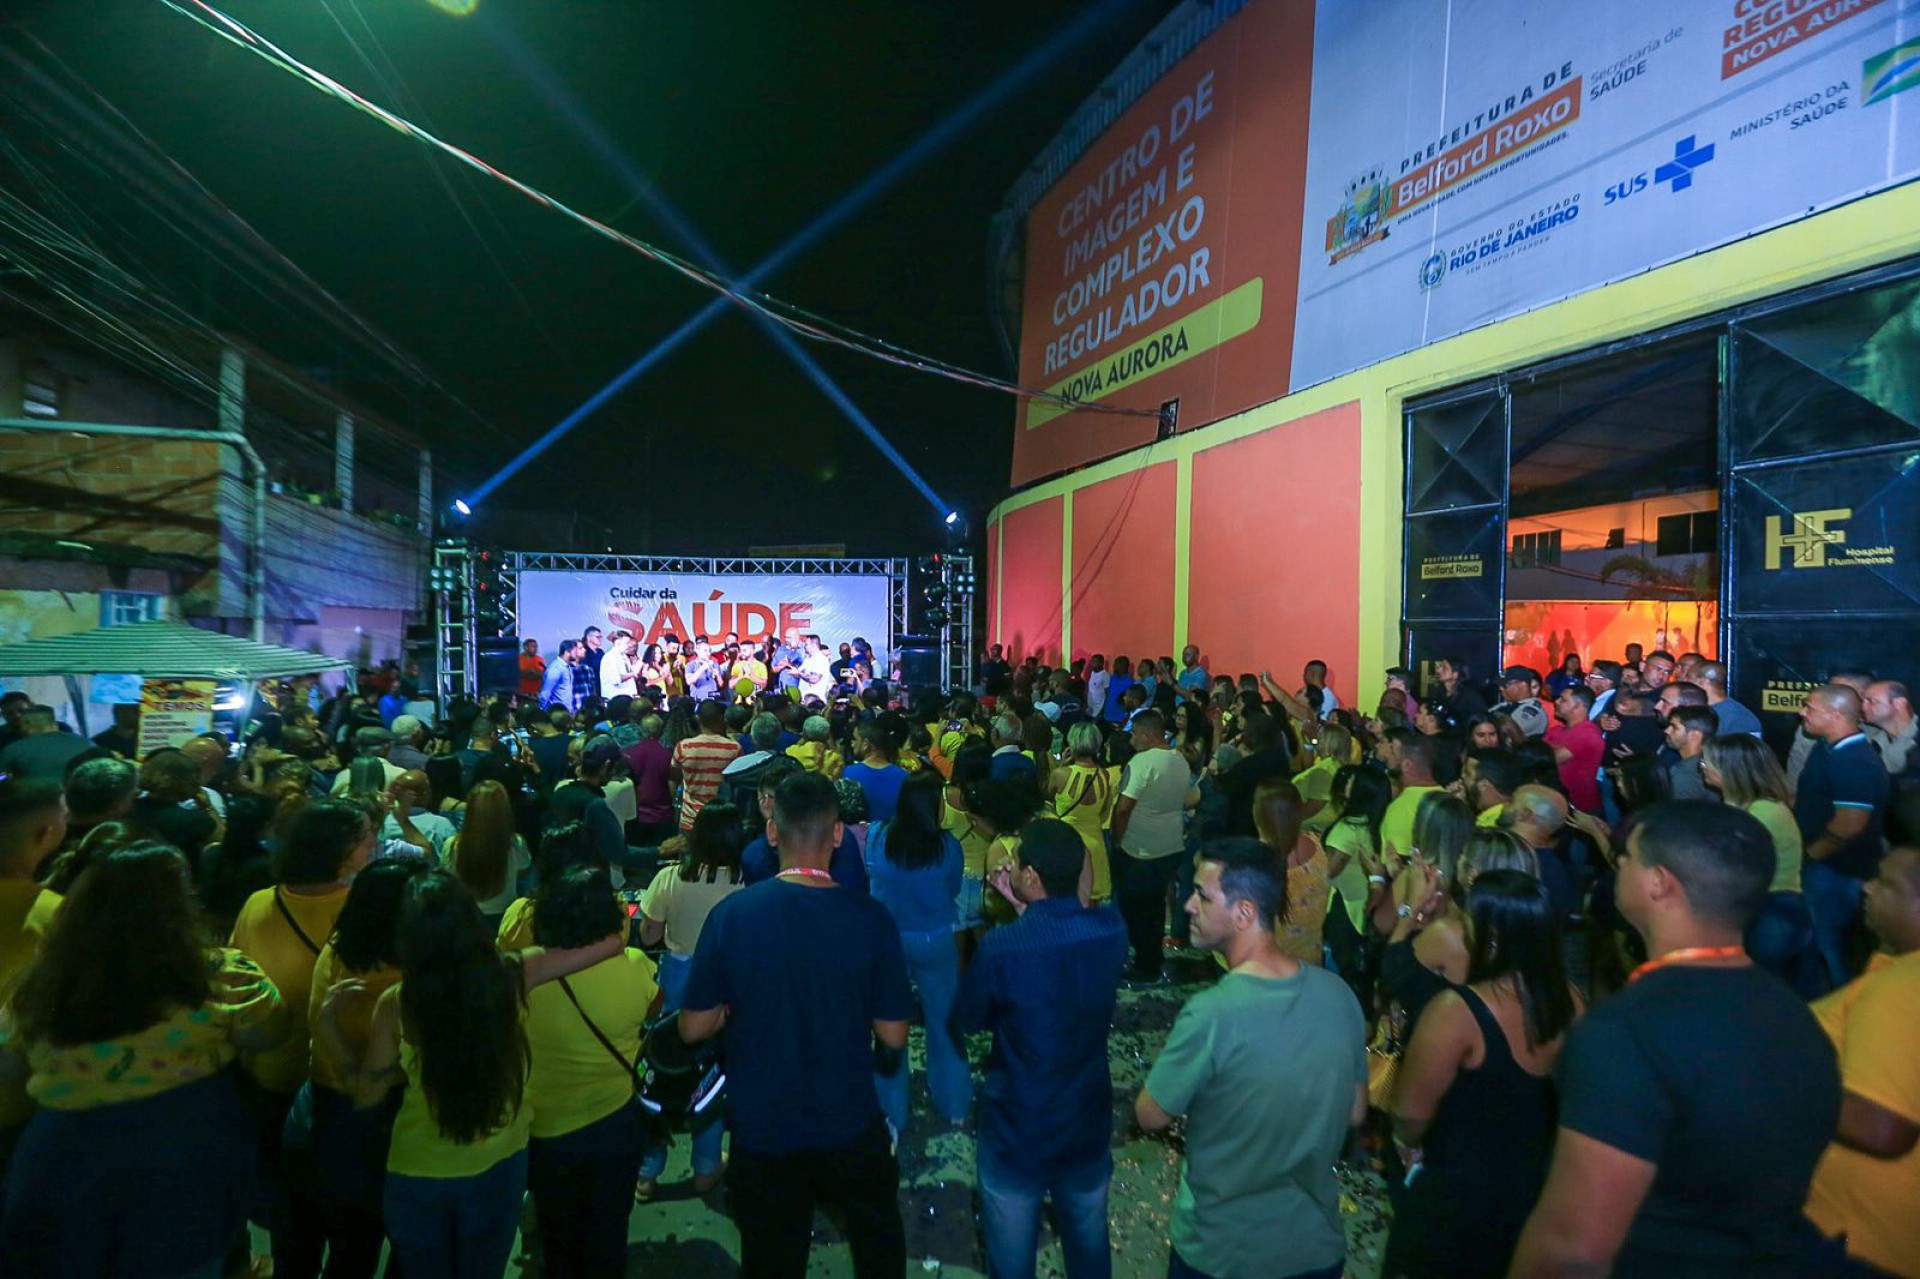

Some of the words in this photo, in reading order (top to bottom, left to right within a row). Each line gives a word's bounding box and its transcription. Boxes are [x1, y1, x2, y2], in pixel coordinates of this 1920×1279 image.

[1723, 0, 1820, 49] REGU
[1733, 24, 1799, 68] NOVA
[1590, 58, 1648, 102] SAÚDE
[1591, 39, 1661, 86] Secretaria
[1664, 26, 1684, 44] de
[1401, 85, 1533, 174] PREFEITURA
[1543, 60, 1573, 91] DE
[1730, 92, 1822, 140] MINISTÉRIO
[1825, 80, 1850, 98] DA
[1790, 96, 1849, 130] SAÚDE
[1057, 126, 1161, 238] CENTRO
[1169, 69, 1215, 147] DE
[1398, 132, 1489, 208] Belford
[1063, 172, 1167, 278] IMAGEM
[1176, 142, 1195, 193] E
[1604, 172, 1648, 206] SUS
[1449, 249, 1477, 272] RIO
[1479, 239, 1501, 259] DE
[1503, 205, 1580, 248] JANEIRO
[1451, 228, 1503, 257] GOVERNO
[1508, 218, 1525, 232] DO
[1530, 192, 1581, 222] ESTADO
[1052, 194, 1206, 327] COMPLEXO
[1043, 245, 1212, 377] REGULADOR
[1060, 368, 1103, 408] NOVA
[1106, 325, 1189, 388] AURORA
[1845, 545, 1895, 557] Hospital
[606, 589, 814, 646] SAÚDE
[610, 586, 658, 599] Cuidar
[659, 587, 677, 600] da
